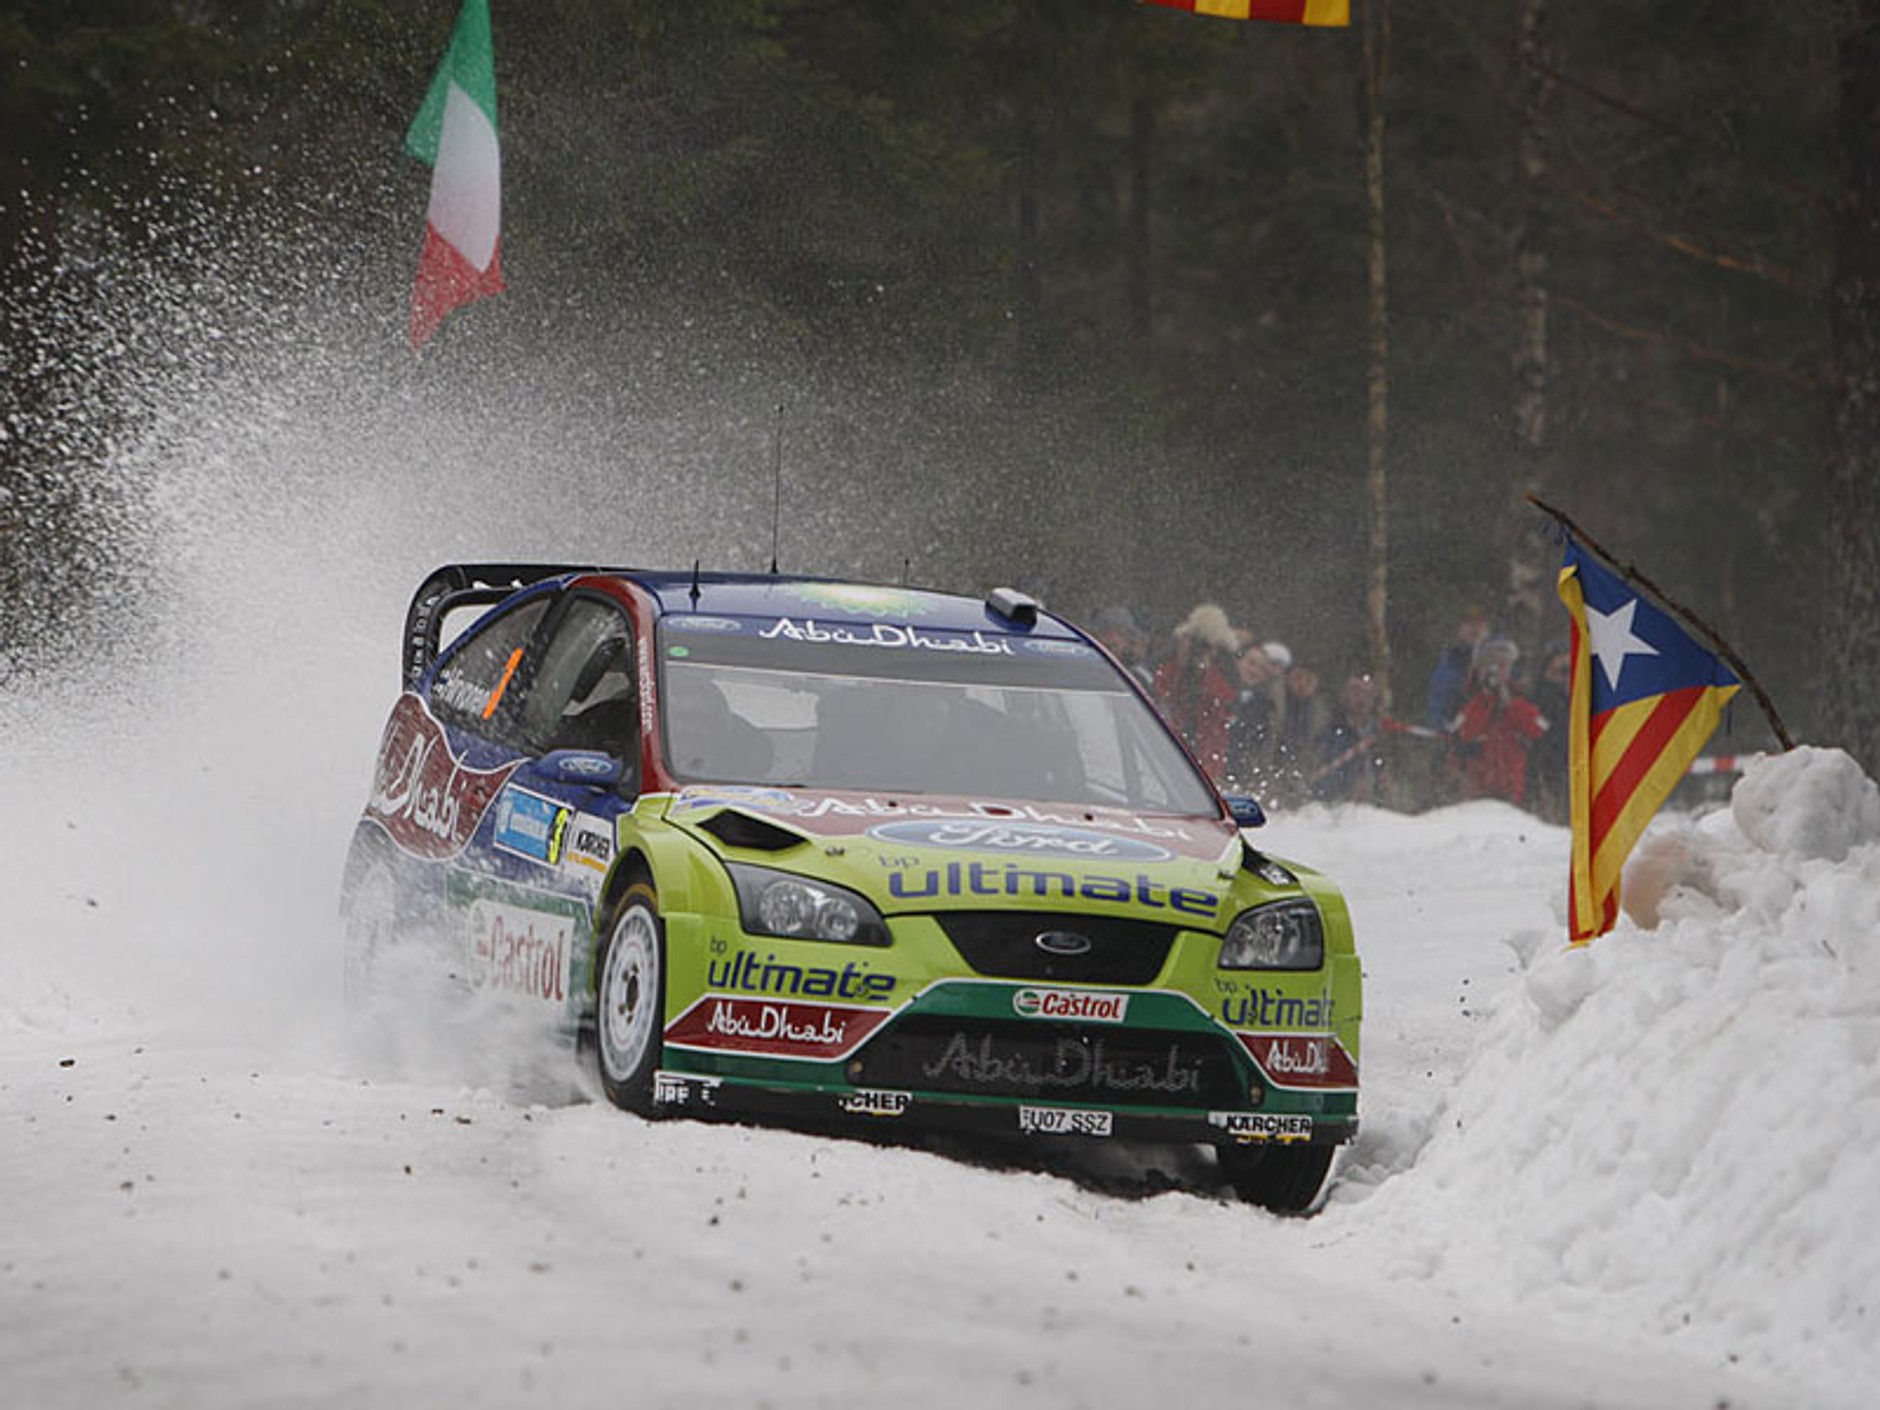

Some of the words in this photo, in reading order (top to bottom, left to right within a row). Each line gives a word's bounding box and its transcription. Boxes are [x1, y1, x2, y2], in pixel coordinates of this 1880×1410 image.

[928, 821, 1118, 855] Ford
[888, 860, 1220, 918] ultimate
[708, 950, 897, 1001] ultimate
[1042, 993, 1121, 1019] Castrol
[1071, 1113, 1108, 1132] SSZ
